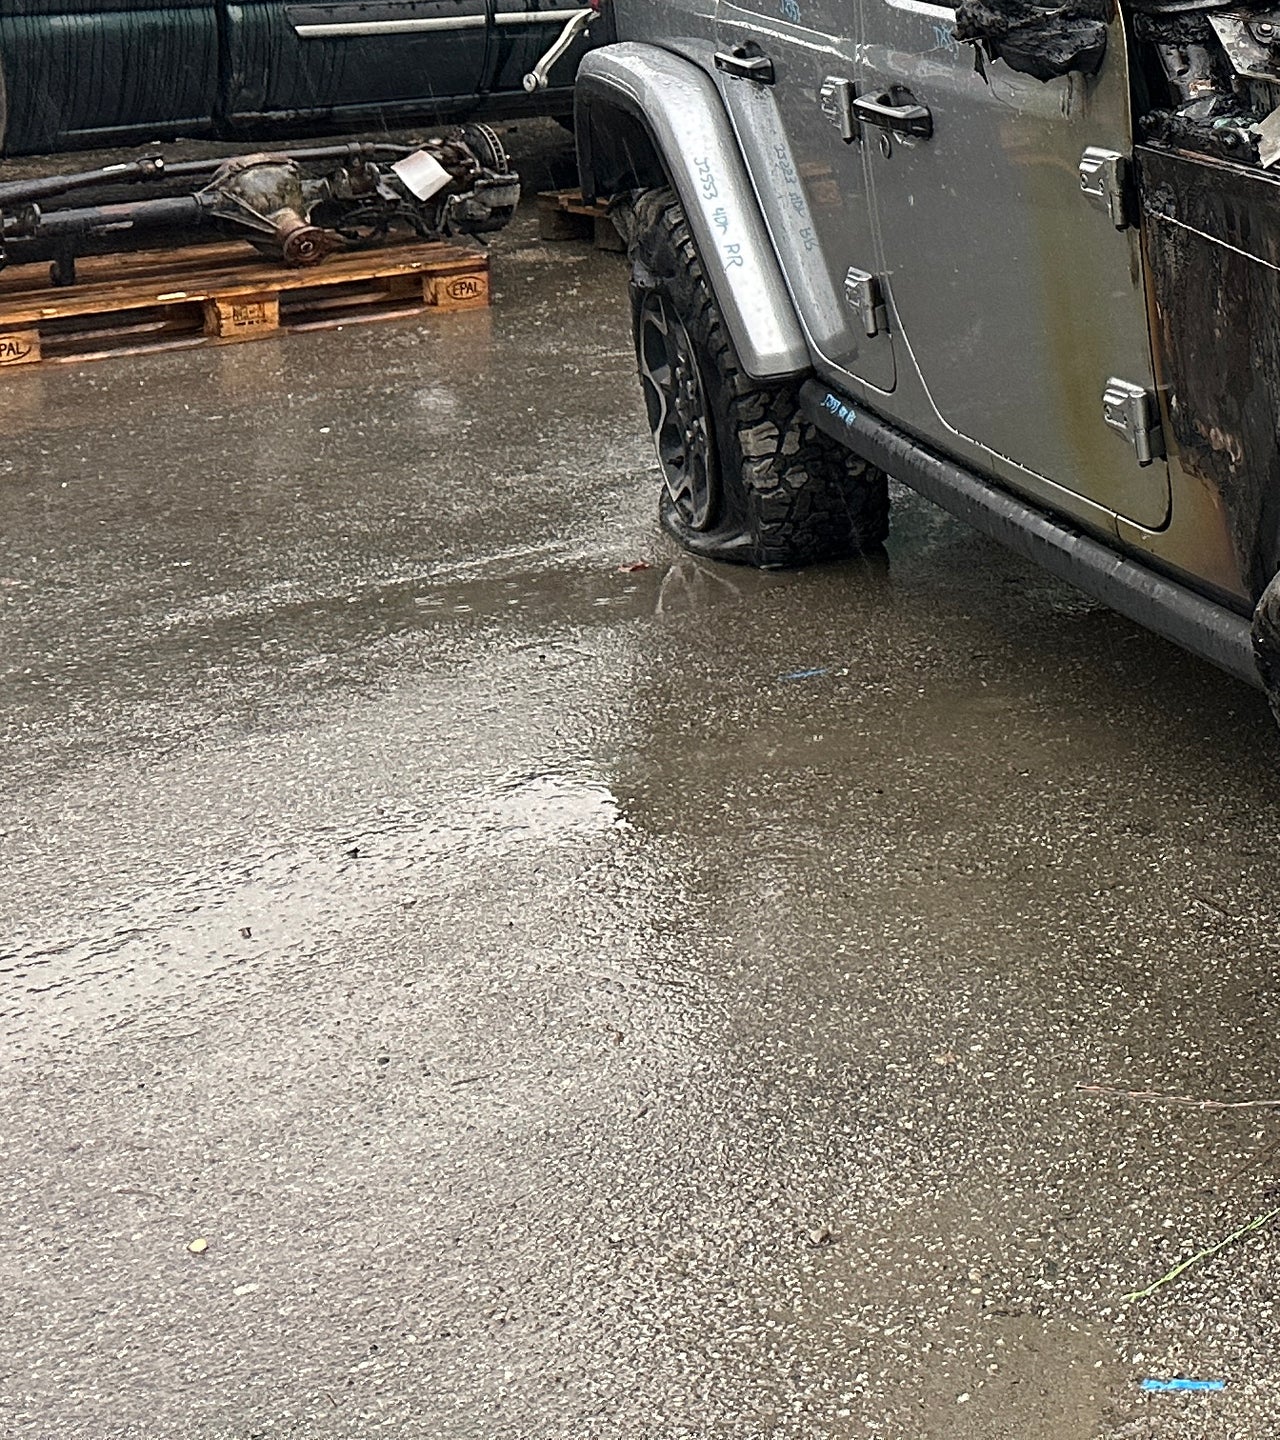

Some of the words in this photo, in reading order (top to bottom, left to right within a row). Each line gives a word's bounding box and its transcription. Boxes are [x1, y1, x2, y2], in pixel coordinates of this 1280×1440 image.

[694, 157, 719, 200] J2553
[723, 243, 744, 273] RR
[453, 281, 479, 296] EPAL
[0, 342, 24, 357] PAL
